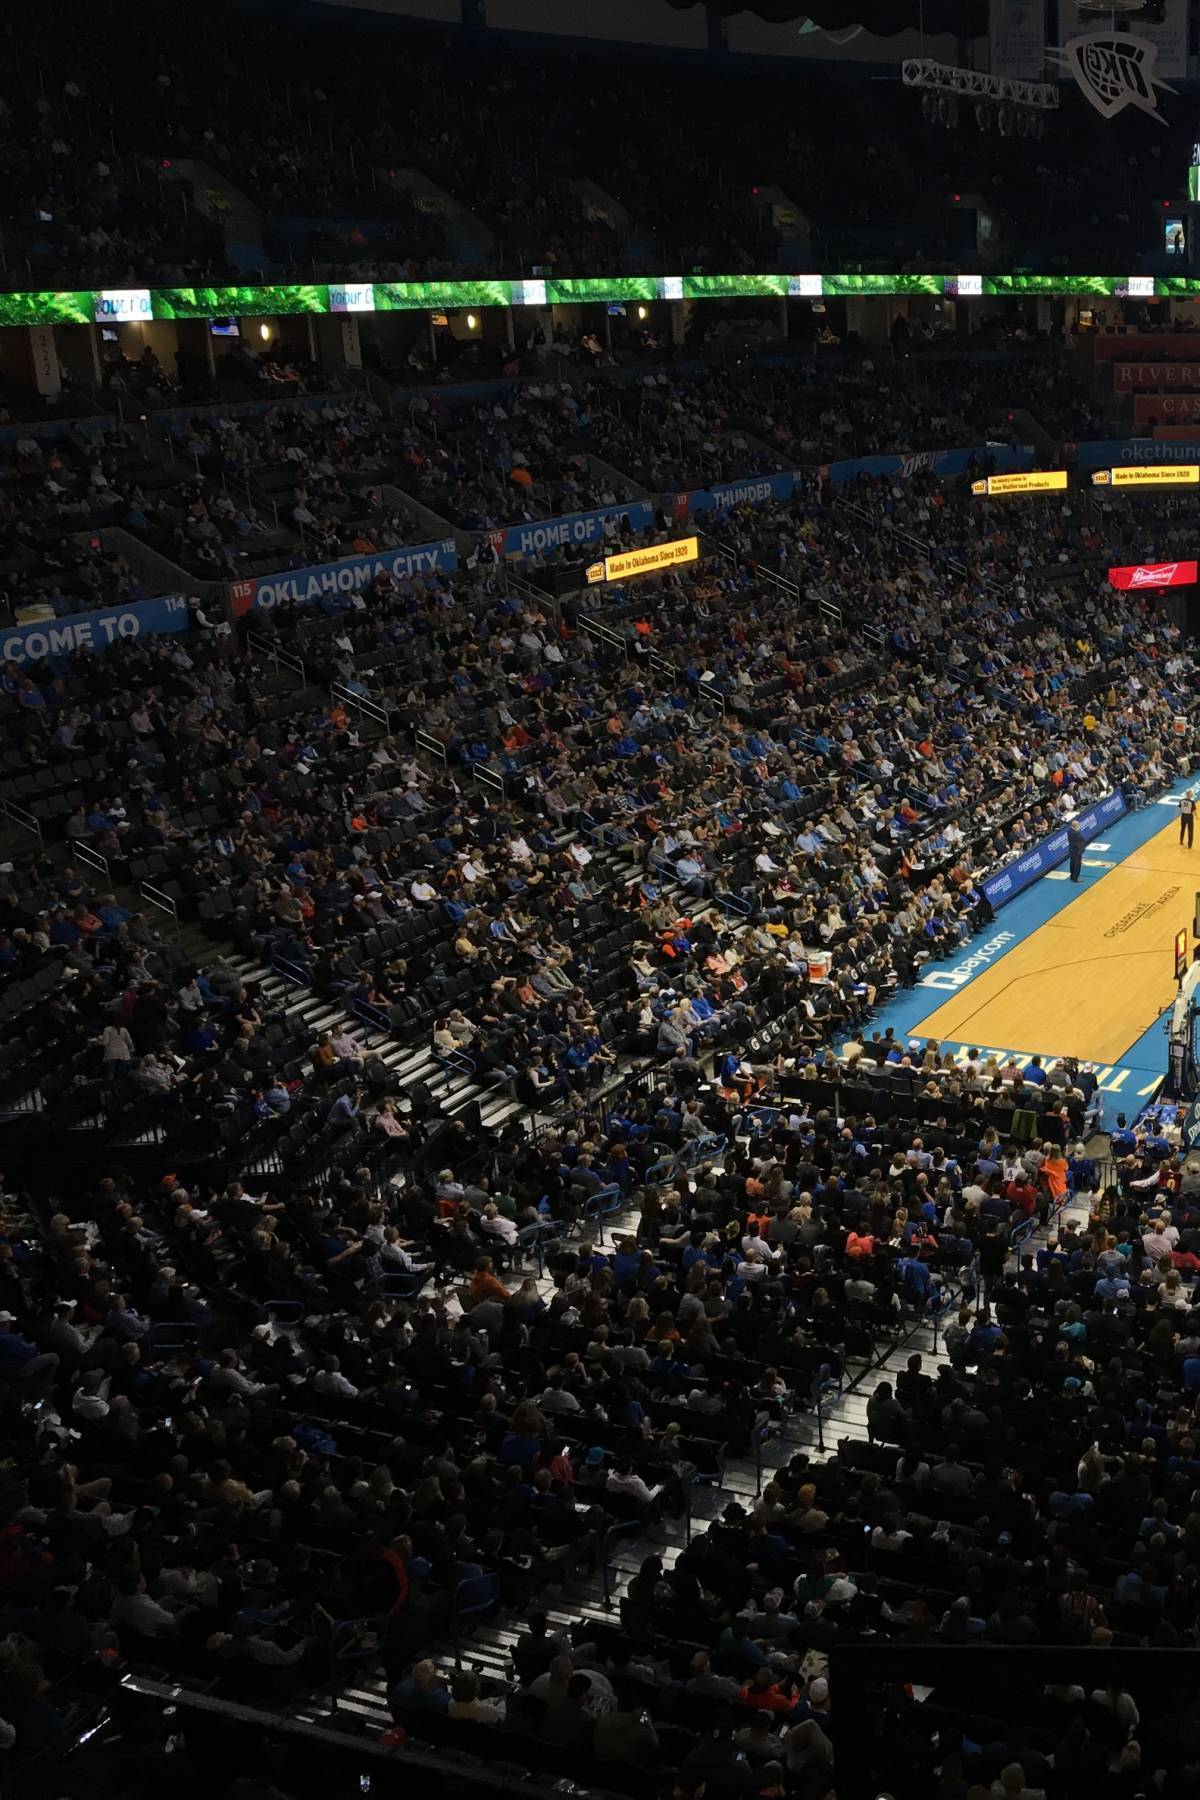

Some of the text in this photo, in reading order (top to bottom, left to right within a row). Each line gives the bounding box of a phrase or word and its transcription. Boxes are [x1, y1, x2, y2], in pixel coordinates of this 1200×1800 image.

[713, 482, 772, 509] THUNDER
[442, 541, 456, 554] 115
[489, 532, 502, 544] 116
[521, 526, 570, 552] HOME
[573, 518, 597, 542] OF
[610, 563, 624, 573] Made
[632, 554, 658, 568] Oklahoma
[660, 550, 674, 561] Since
[675, 546, 687, 557] 1920
[231, 583, 252, 597] 115
[257, 549, 438, 609] OKLAHOMA CITY
[165, 595, 186, 612] 114
[3, 613, 140, 665] COME TO
[1104, 903, 1150, 937] CHESAPEAKE
[1156, 886, 1182, 905] ARENA
[958, 931, 1013, 977] paycom
